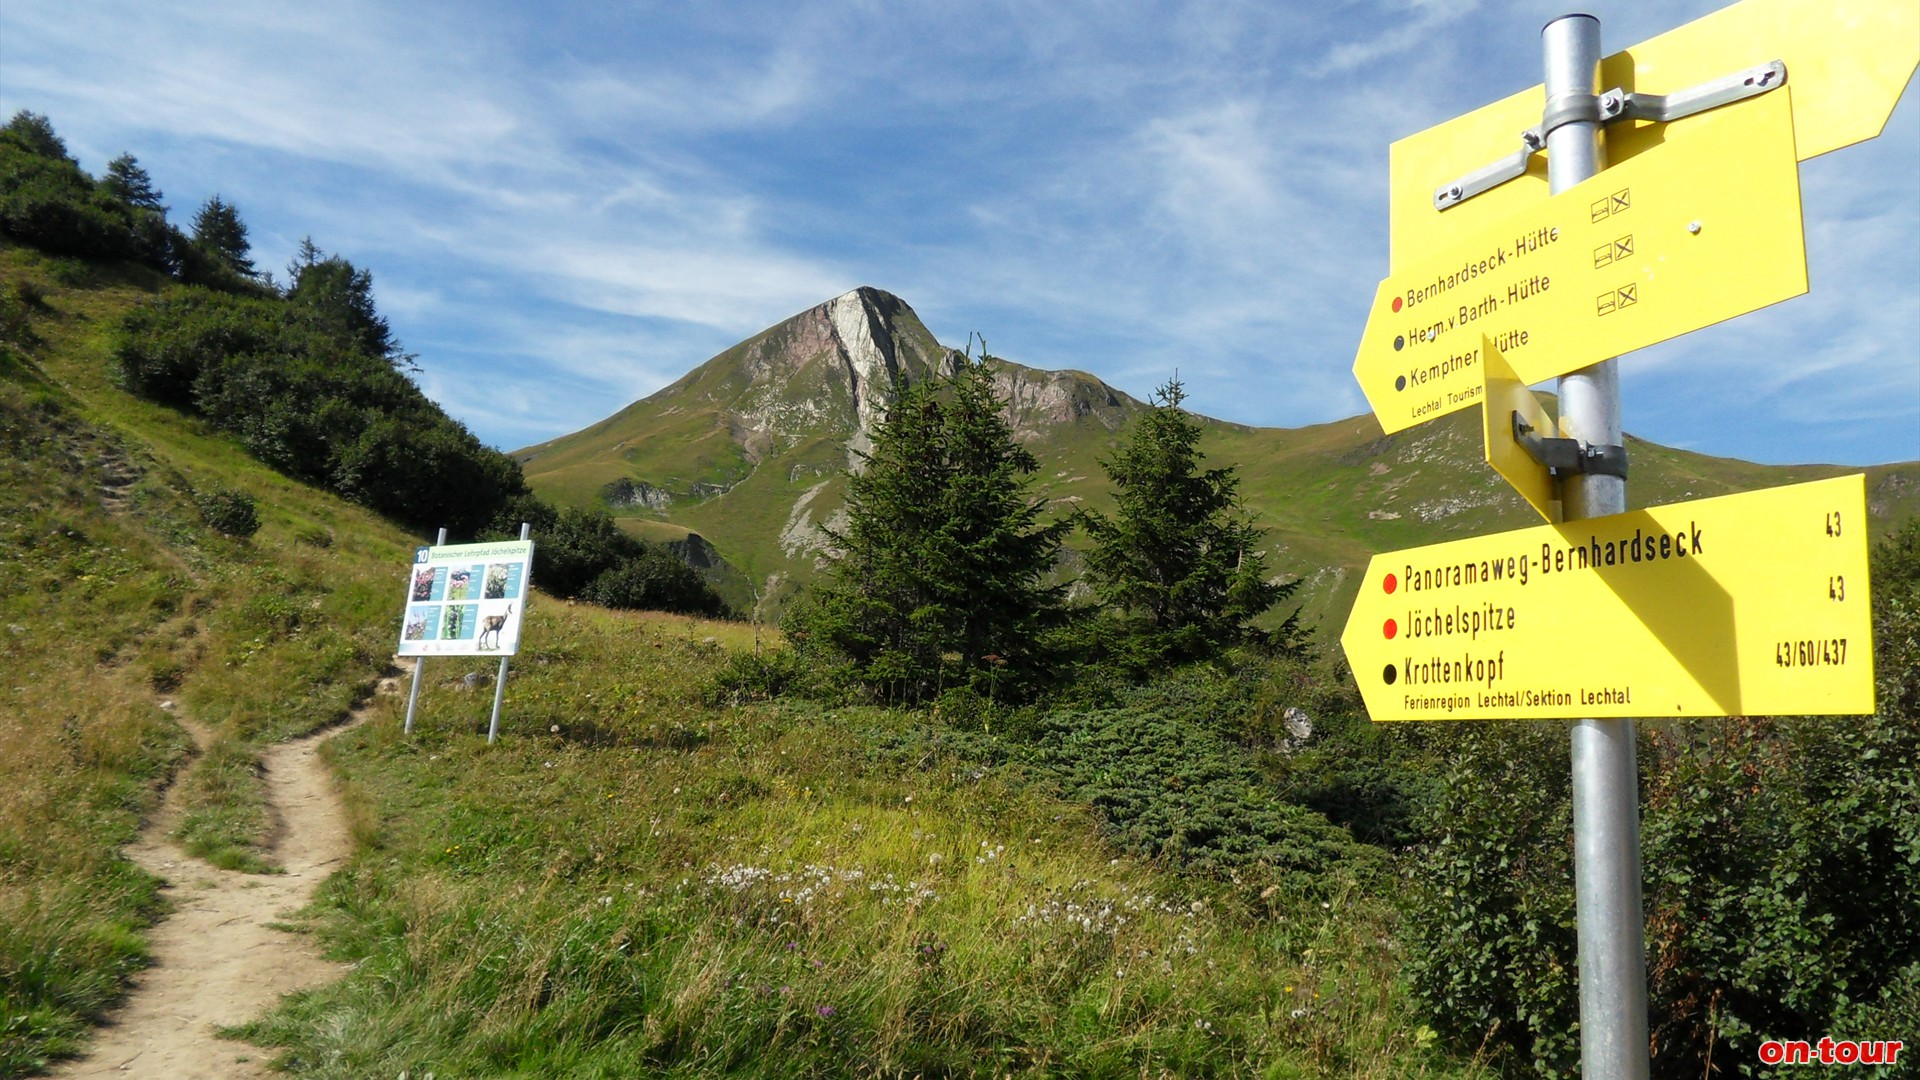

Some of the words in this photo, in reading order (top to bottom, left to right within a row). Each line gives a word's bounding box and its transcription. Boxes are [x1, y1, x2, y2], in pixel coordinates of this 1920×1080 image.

[1407, 227, 1559, 308] Bernhardseck-Hütte
[1410, 349, 1479, 388] Kemptner
[1412, 397, 1442, 418] Lechtal
[1447, 384, 1483, 405] Tourism
[417, 549, 428, 562] 10
[431, 551, 463, 559] Botanischer
[464, 549, 490, 557] Lehrpfad
[491, 546, 527, 555] Jöchelspitze
[1404, 521, 1704, 593] Panoramaweg-Bernhardseck
[1826, 511, 1842, 538] 43
[1405, 601, 1516, 640] Jöchelspitze
[1829, 575, 1845, 602] 43
[1404, 650, 1504, 688] Krottenkopf
[1775, 638, 1848, 668] 43/60/437
[1404, 692, 1471, 713] Ferienregion
[1477, 688, 1572, 708] Lechtal/Sektion
[1580, 686, 1631, 705] Lechtal
